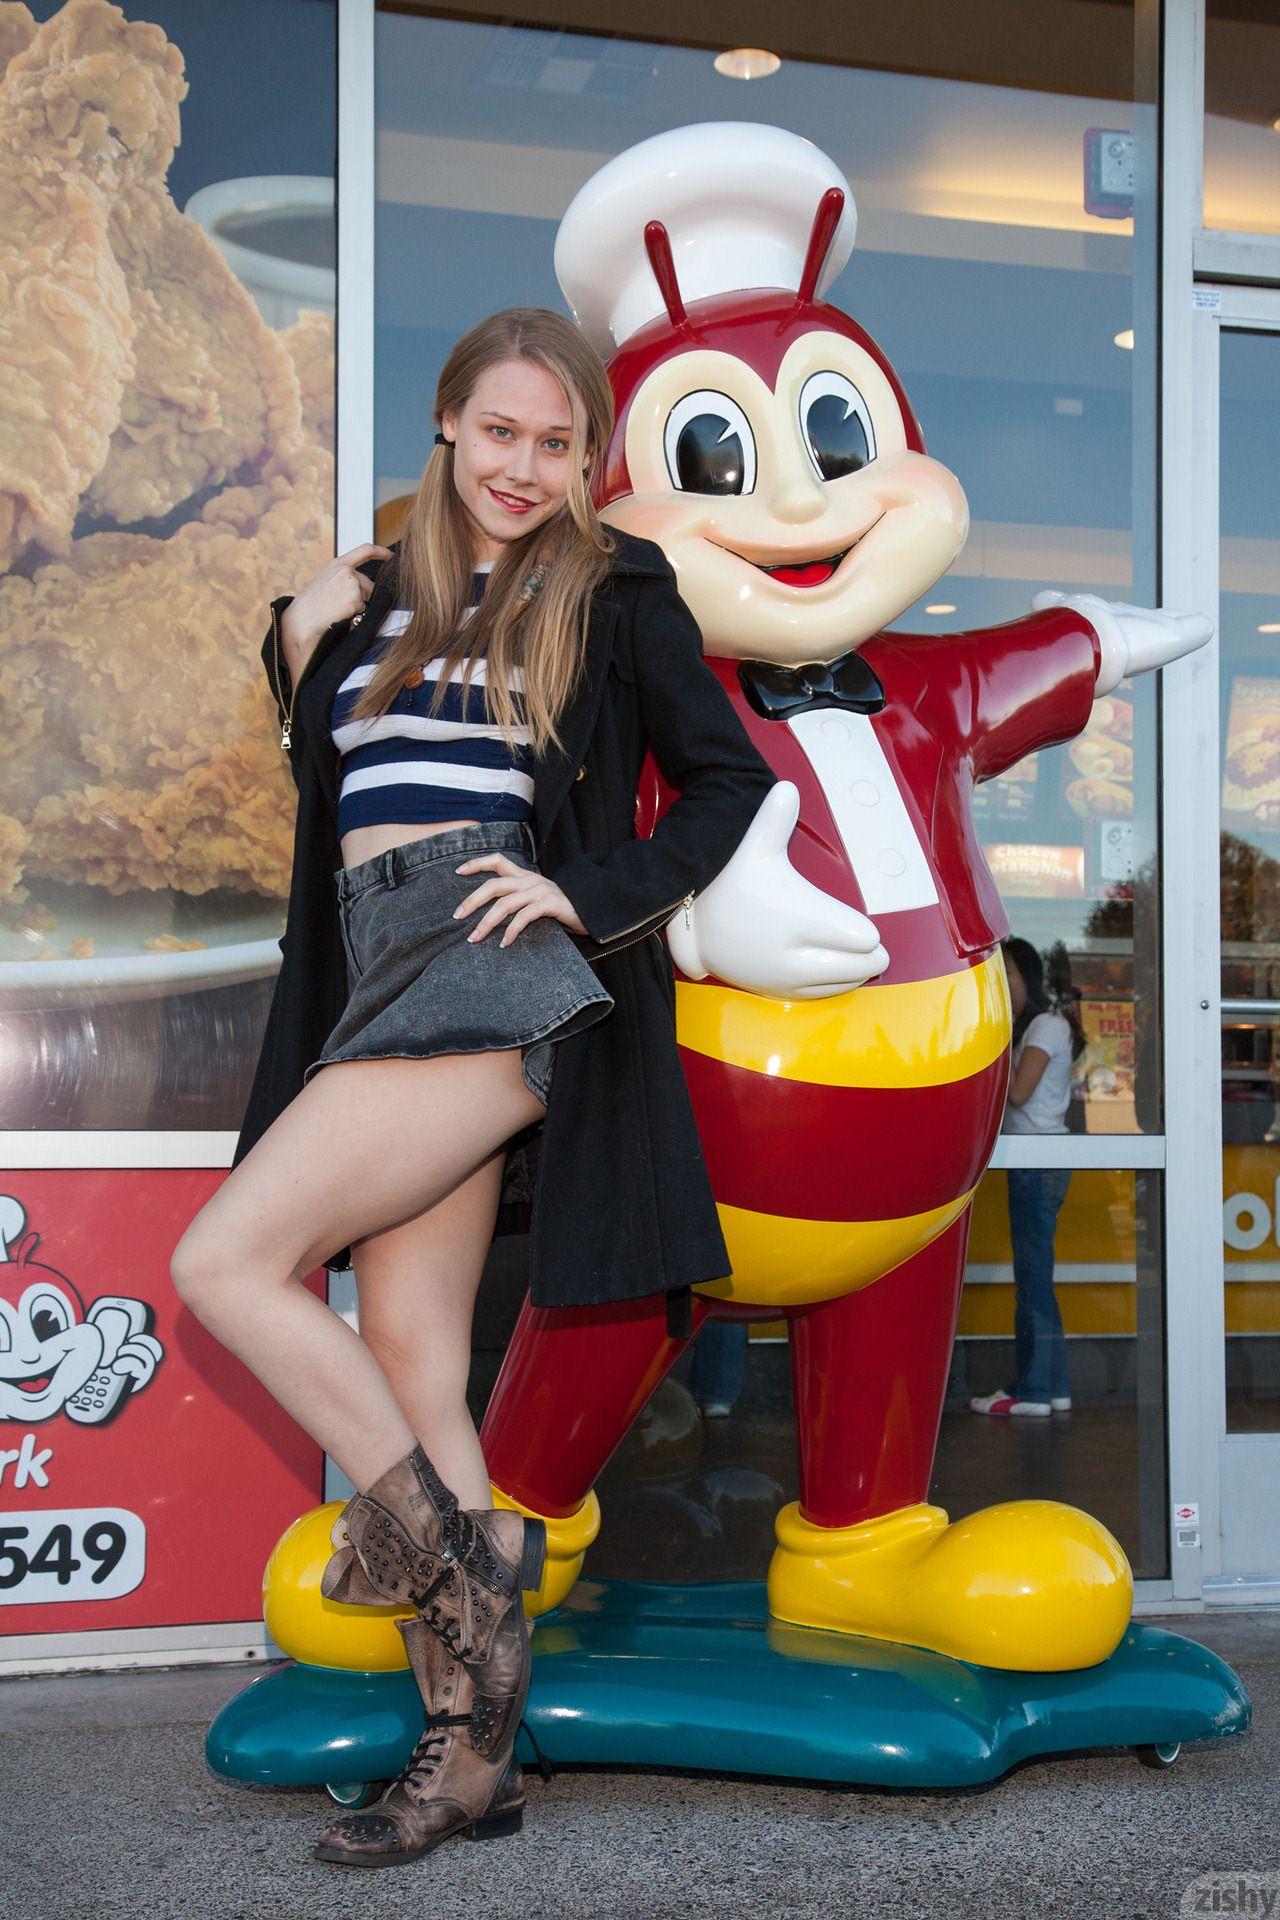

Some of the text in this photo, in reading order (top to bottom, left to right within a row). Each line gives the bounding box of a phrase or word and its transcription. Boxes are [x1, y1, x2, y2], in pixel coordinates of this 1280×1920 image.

[993, 845, 1061, 860] Chicken
[1098, 1019, 1134, 1033] FREE
[0, 1433, 53, 1489] rk
[0, 1521, 127, 1590] 549
